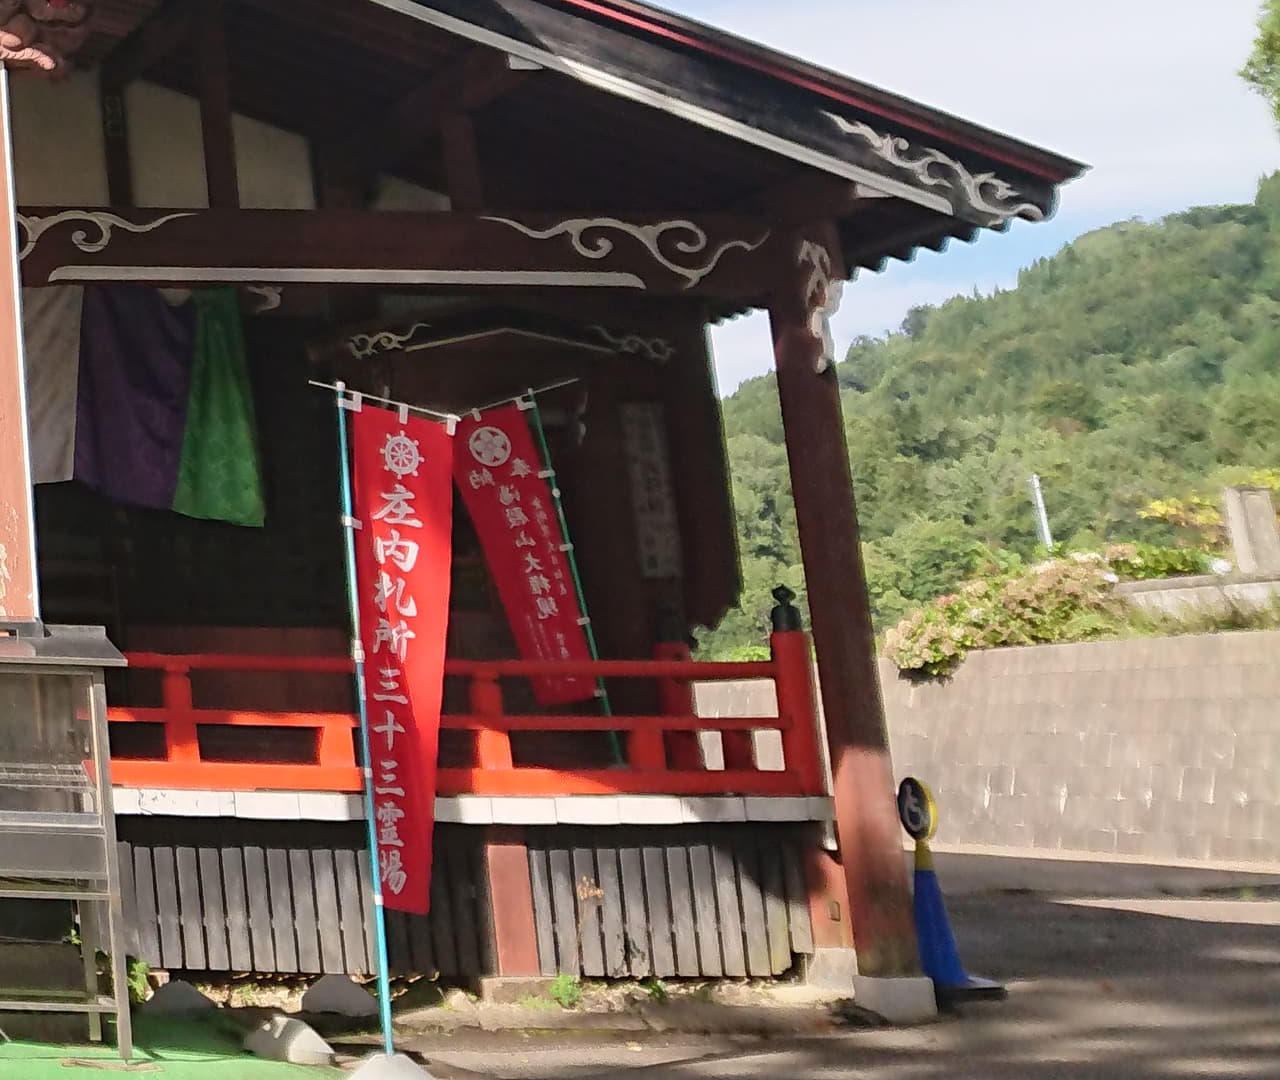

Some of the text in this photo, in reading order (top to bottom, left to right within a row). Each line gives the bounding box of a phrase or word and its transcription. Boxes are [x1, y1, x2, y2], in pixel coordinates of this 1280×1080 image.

[371, 484, 423, 897] 庄内札所三十三霊場
